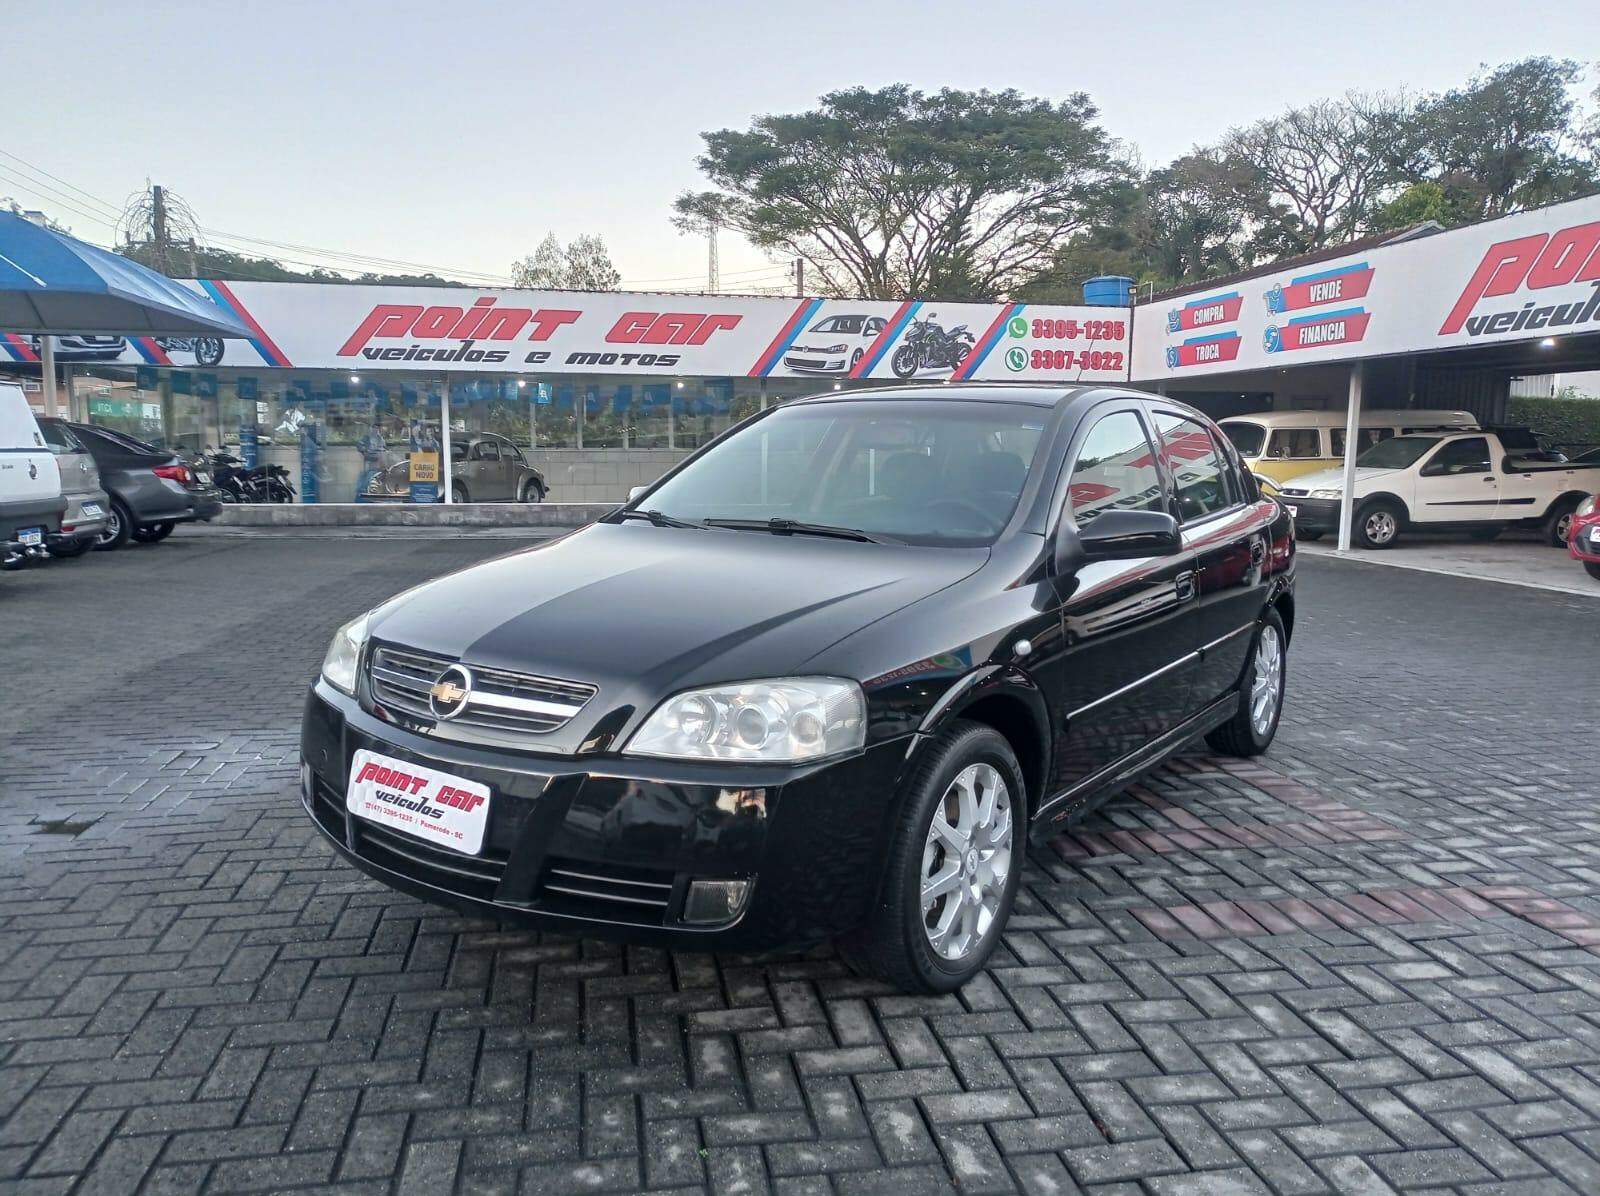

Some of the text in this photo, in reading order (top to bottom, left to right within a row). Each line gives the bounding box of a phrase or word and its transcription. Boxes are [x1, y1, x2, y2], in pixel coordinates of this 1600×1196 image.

[1309, 280, 1342, 303] VENDE
[1193, 305, 1224, 325] COMPRA
[1466, 281, 1600, 337] veicul
[1031, 319, 1125, 340] 3395-1235
[1299, 322, 1345, 345] FINANCIA
[525, 351, 551, 364] e
[1031, 349, 1124, 370] 3387-3922
[1195, 344, 1220, 361] TROCA
[415, 471, 434, 479] NOVO
[376, 790, 445, 819] veiculos
